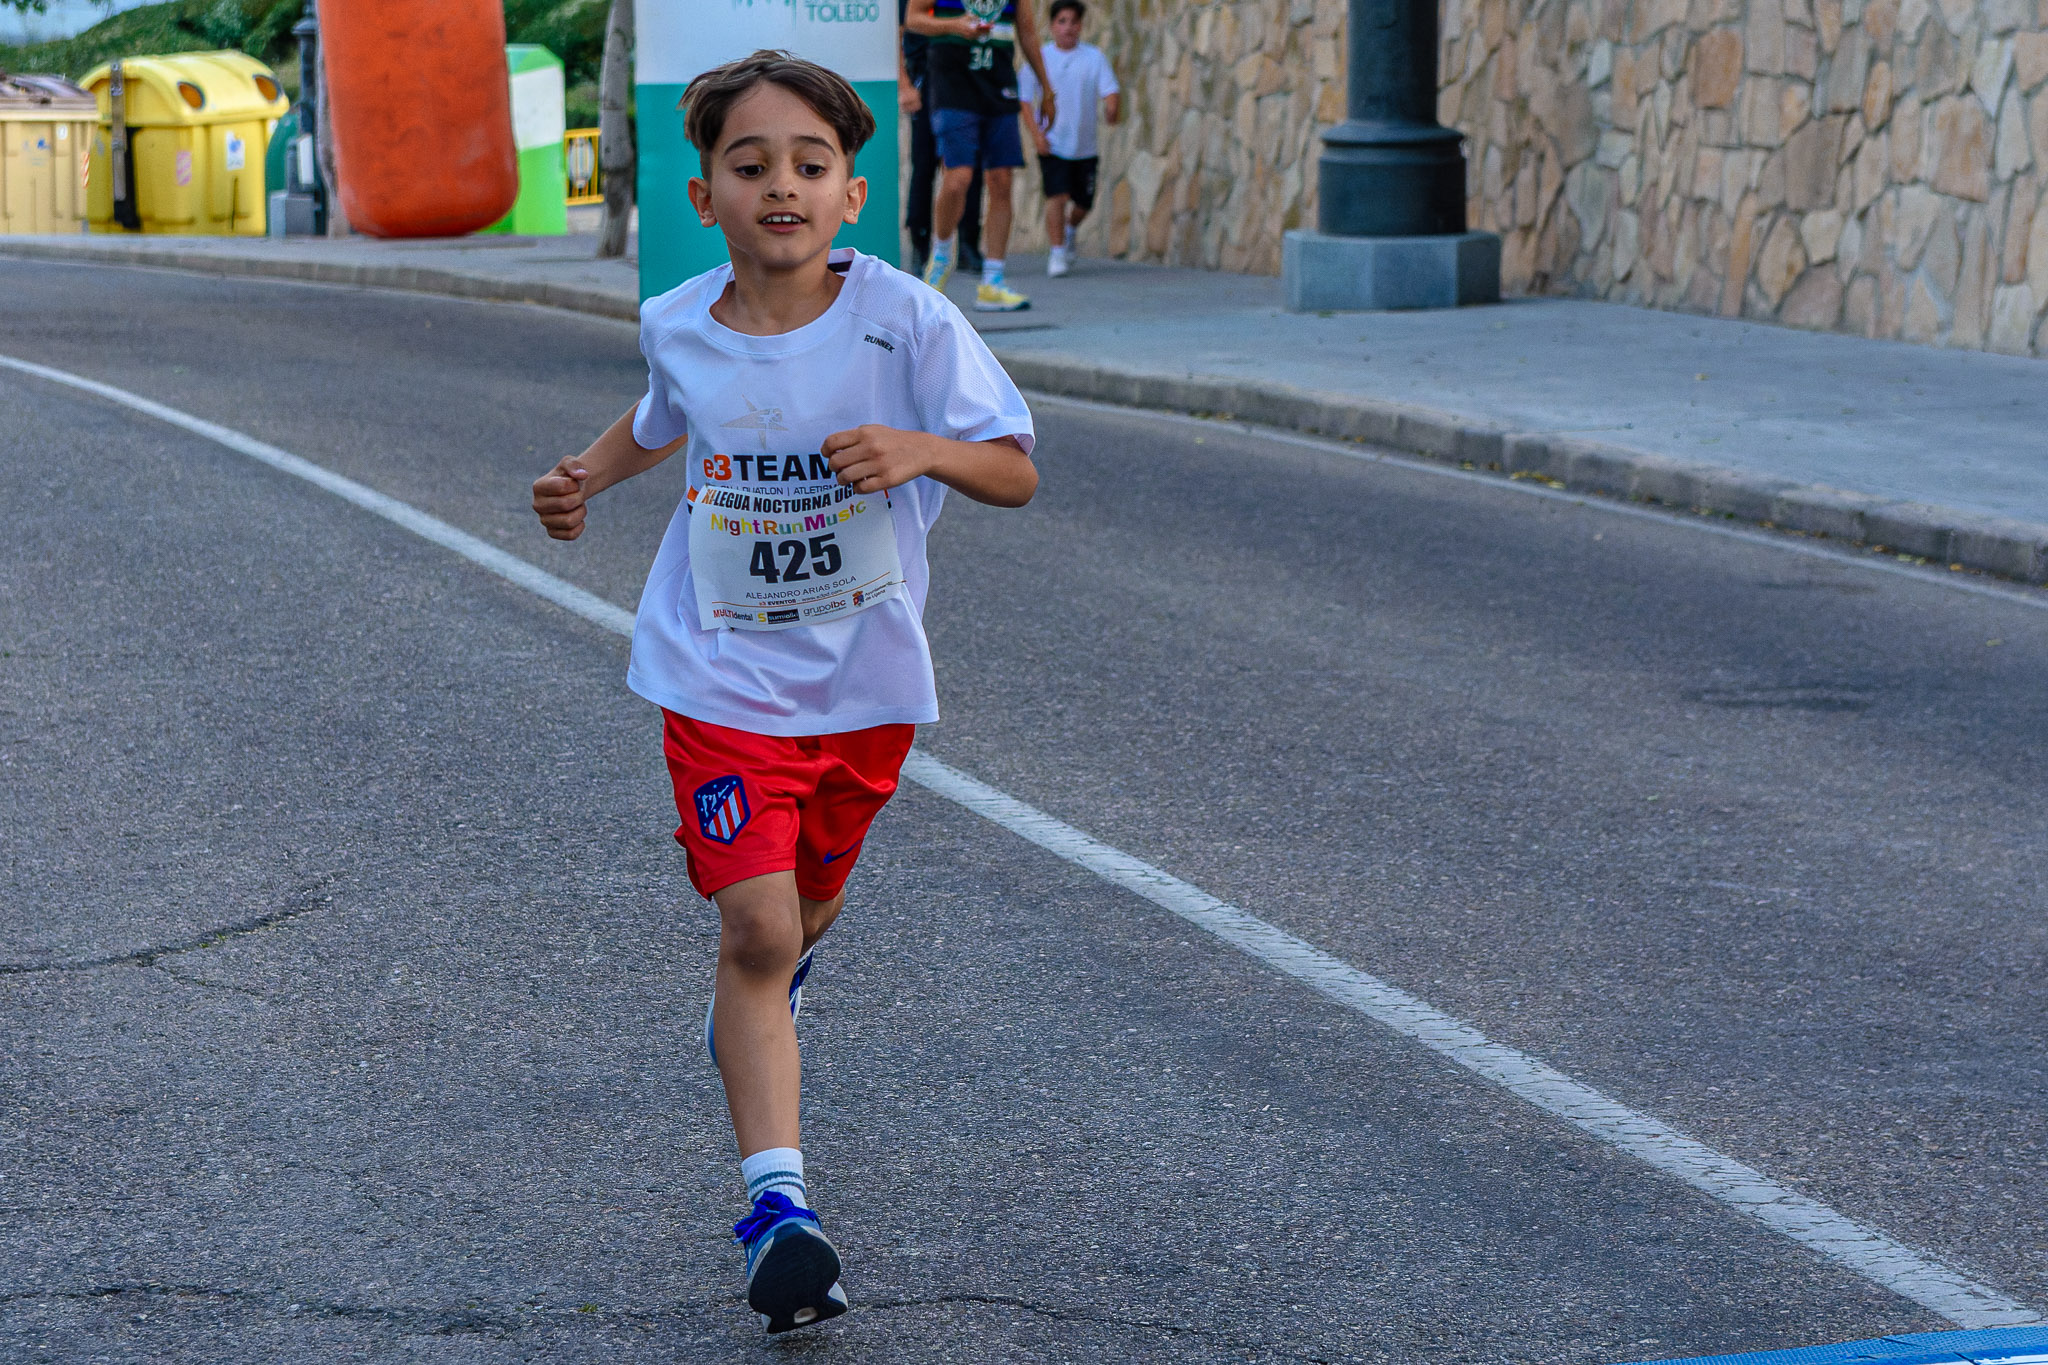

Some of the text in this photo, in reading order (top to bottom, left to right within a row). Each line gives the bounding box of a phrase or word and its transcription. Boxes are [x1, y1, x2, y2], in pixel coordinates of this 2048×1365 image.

[806, 3, 880, 22] TOLEDO
[968, 45, 993, 71] 34
[864, 334, 895, 354] RUNNEK
[713, 490, 750, 511] LEGUA
[753, 493, 831, 513] NOCTURNA
[750, 532, 842, 584] 425
[745, 589, 801, 600] ALEJANDRO
[802, 583, 831, 596] ARIAS
[832, 575, 857, 588] SOLA
